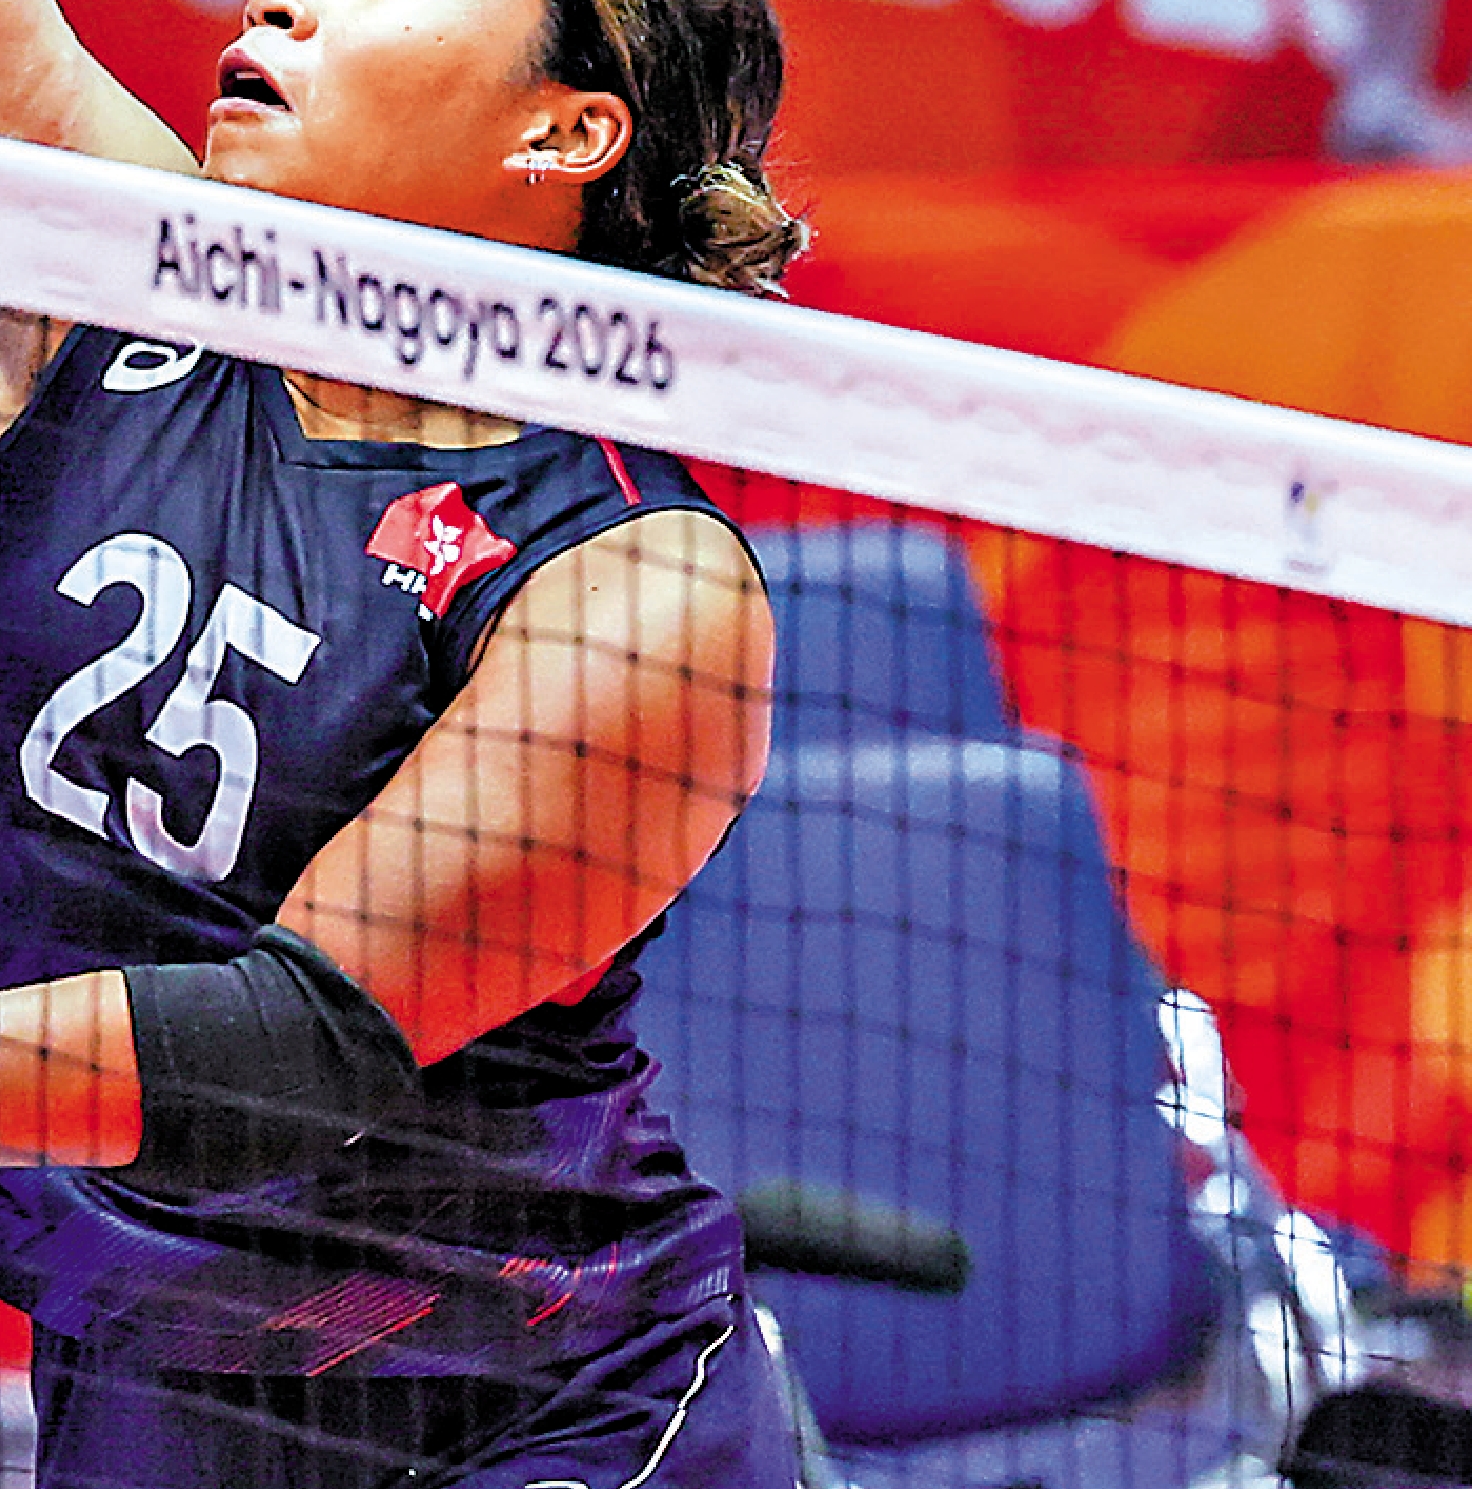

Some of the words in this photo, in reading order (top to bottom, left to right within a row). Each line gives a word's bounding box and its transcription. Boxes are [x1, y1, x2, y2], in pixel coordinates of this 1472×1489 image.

[153, 213, 519, 381] Aichi-Nagoya
[539, 298, 676, 391] 2026
[19, 532, 321, 880] 25
